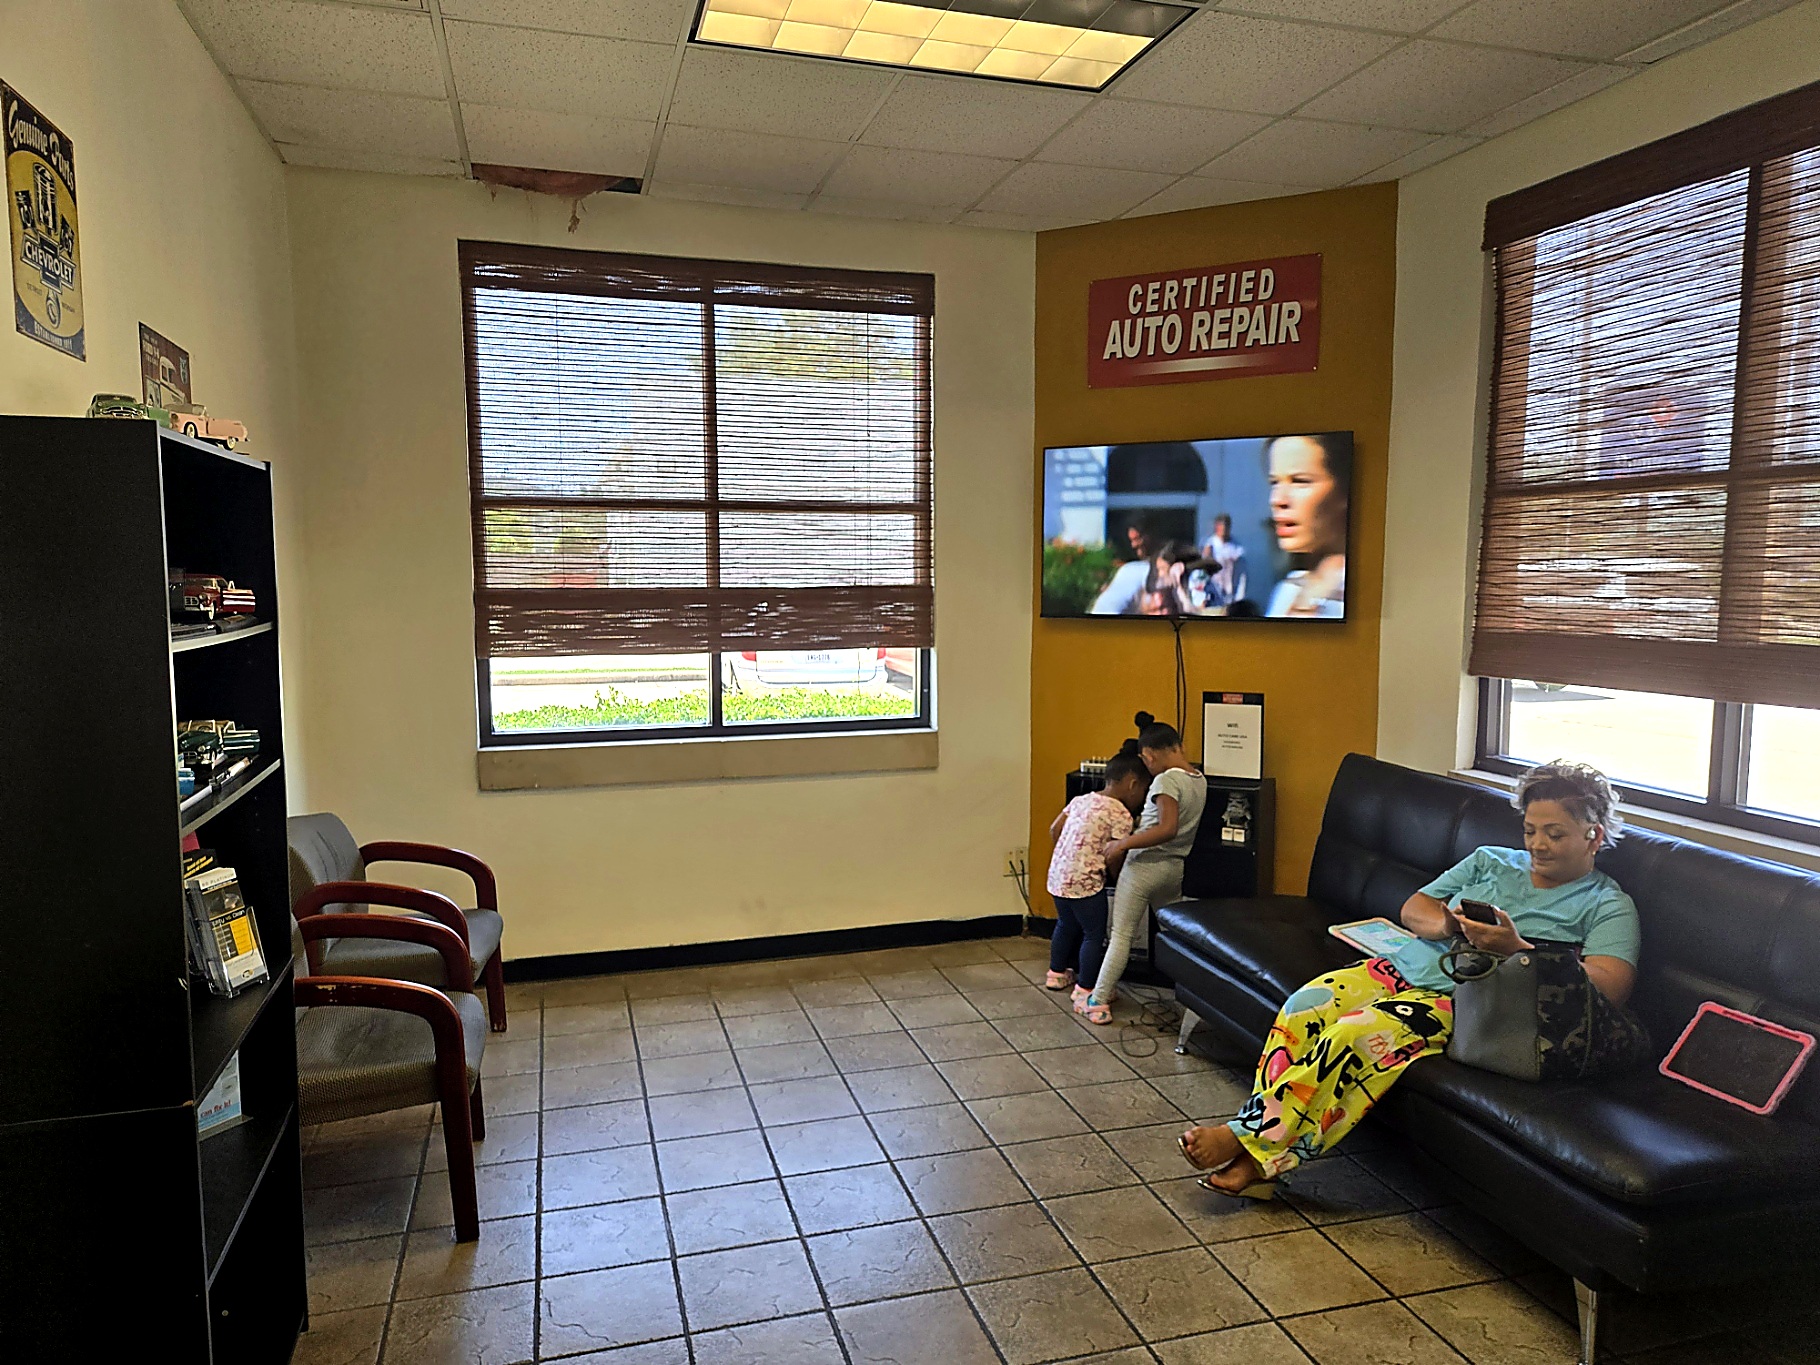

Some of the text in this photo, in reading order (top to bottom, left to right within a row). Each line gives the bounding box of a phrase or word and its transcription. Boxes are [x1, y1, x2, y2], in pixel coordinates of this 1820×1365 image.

[9, 100, 75, 191] Genuine Parts
[25, 240, 73, 284] CHEVROLET
[1128, 268, 1275, 315] CERTIFIED
[1103, 301, 1302, 360] AUTO REPAIR
